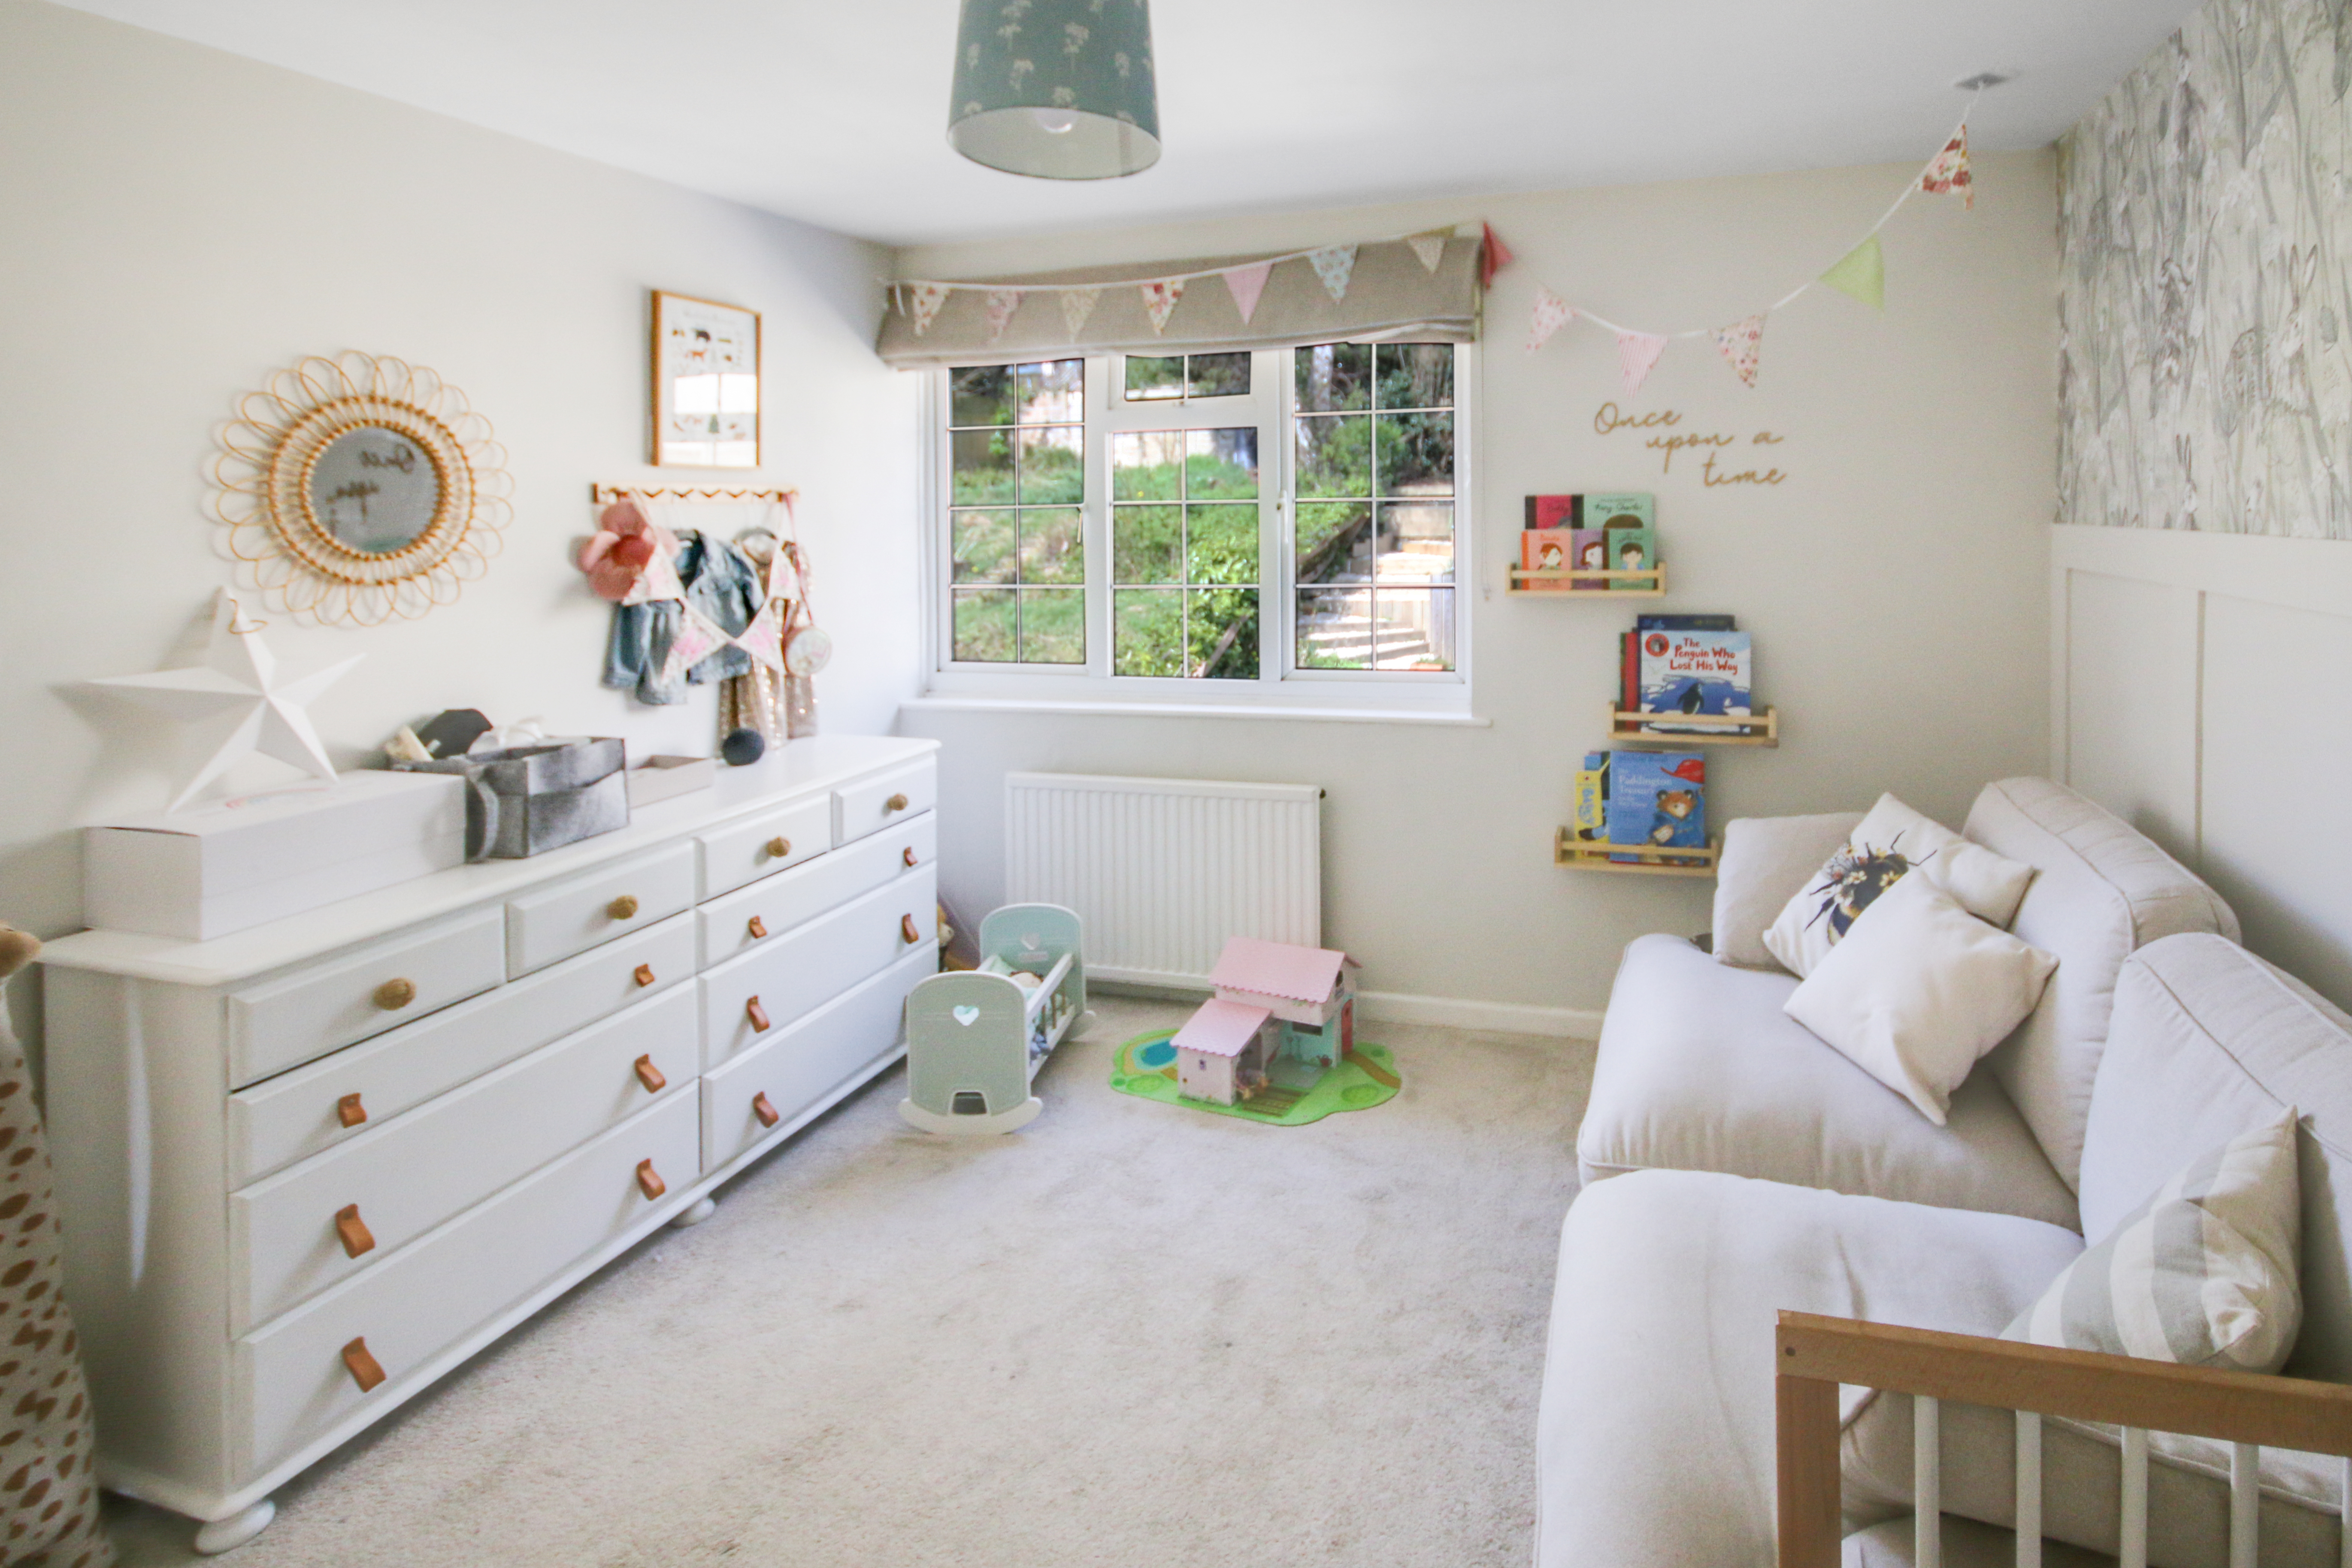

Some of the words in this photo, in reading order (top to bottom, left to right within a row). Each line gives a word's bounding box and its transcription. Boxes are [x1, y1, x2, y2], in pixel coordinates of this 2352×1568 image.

[1594, 402, 1683, 435] Once
[1646, 432, 1734, 474] upon
[1752, 432, 1784, 445] a
[1702, 452, 1787, 487] time
[1683, 637, 1700, 647] The
[1674, 644, 1710, 661] Penguin
[1712, 647, 1736, 659] Who
[1670, 659, 1692, 670] Lost
[1696, 659, 1714, 671] His
[1716, 659, 1738, 675] Way
[1618, 775, 1672, 787] Paddington
